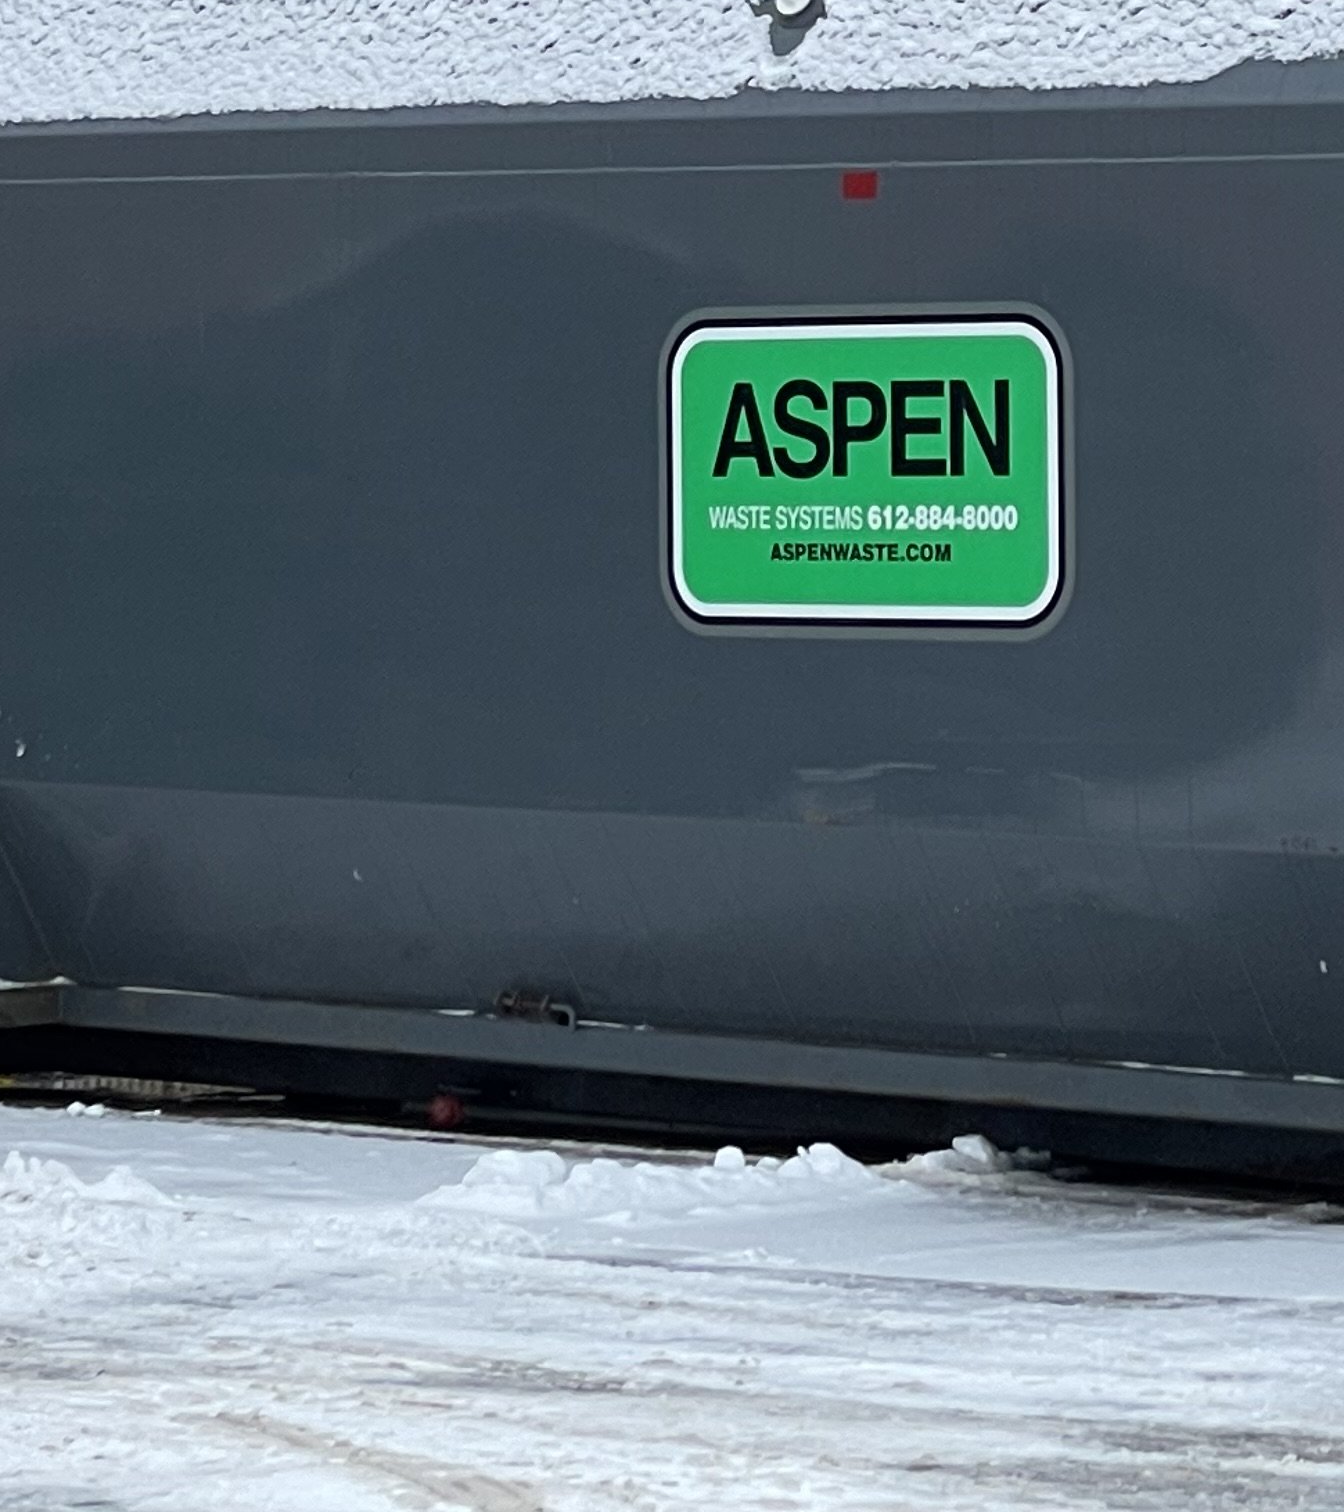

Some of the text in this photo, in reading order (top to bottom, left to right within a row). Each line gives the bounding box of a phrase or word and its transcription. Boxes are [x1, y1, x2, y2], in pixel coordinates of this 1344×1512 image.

[712, 378, 1010, 479] ASPEN
[709, 504, 1019, 530] WASTE SYSTEMS 612-884-8000
[770, 542, 952, 562] ASPENWASTE.COM
